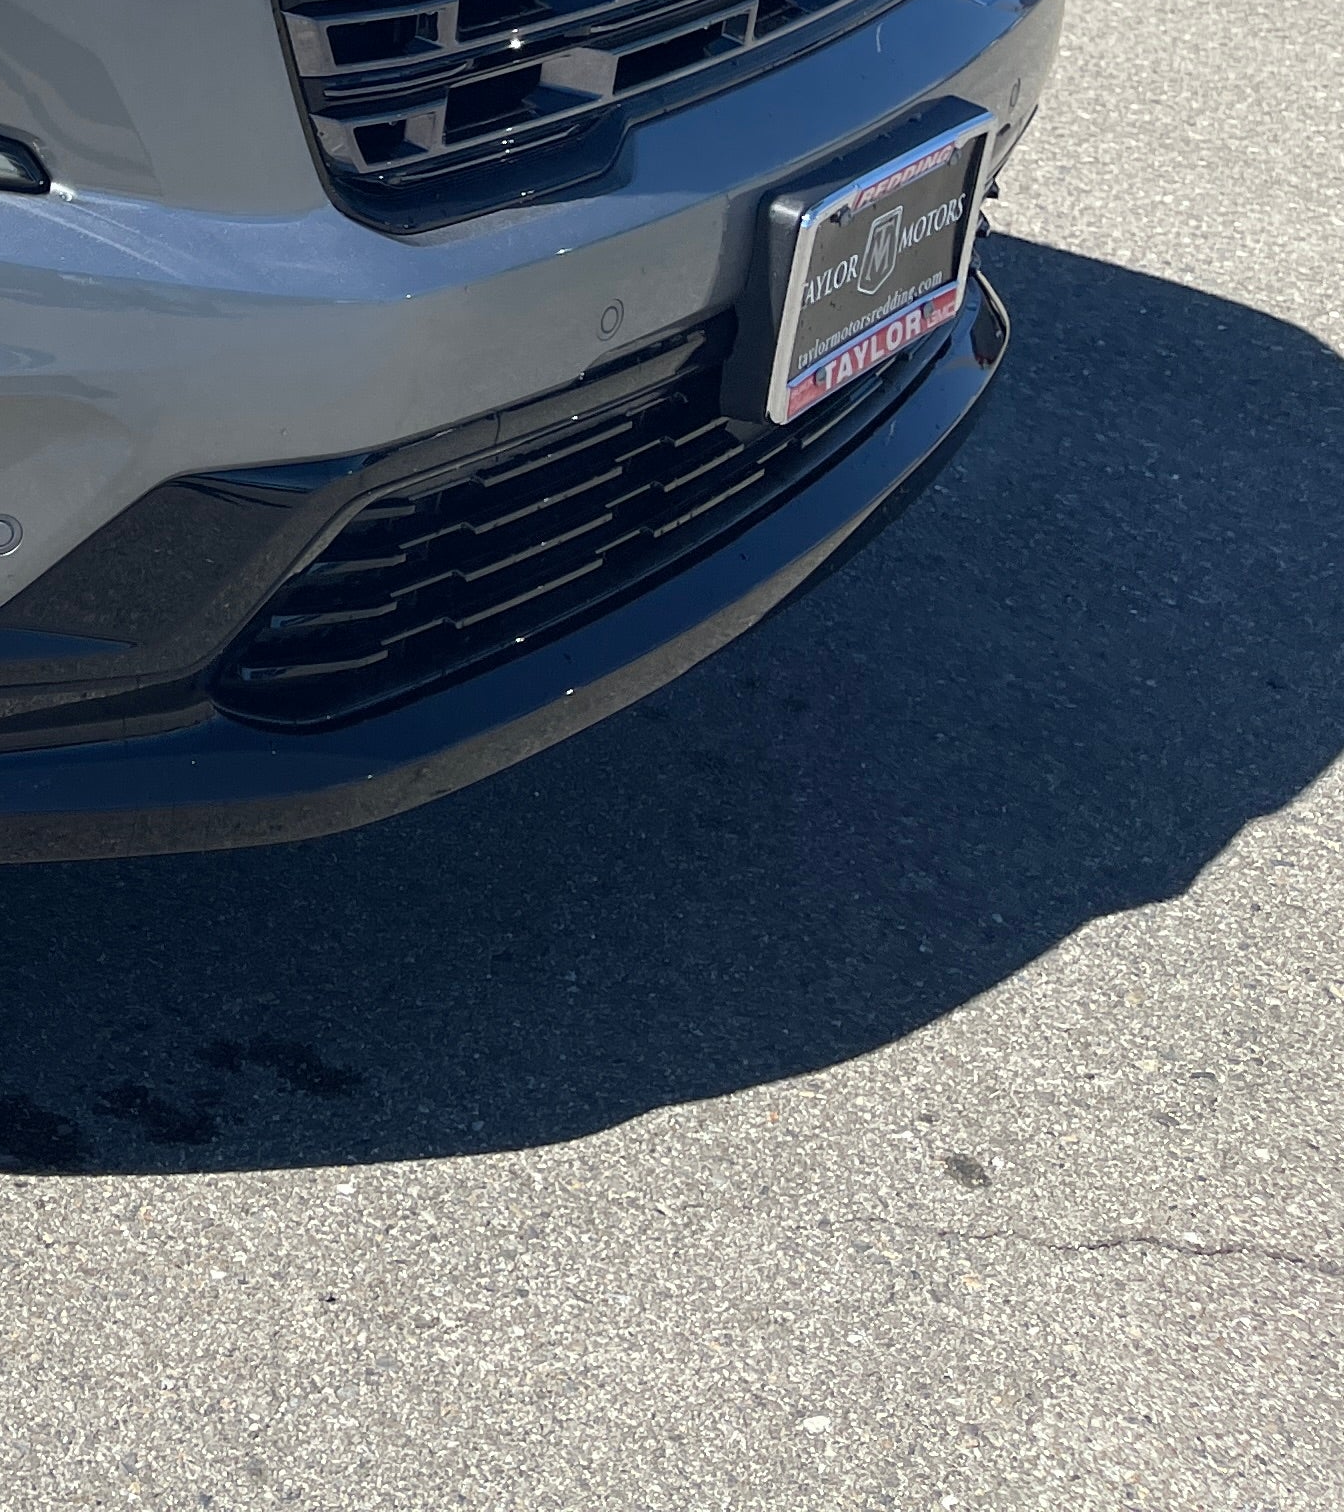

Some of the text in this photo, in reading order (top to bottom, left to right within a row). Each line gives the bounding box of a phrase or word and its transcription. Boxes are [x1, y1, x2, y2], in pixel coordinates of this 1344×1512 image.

[858, 144, 954, 206] REDDING
[898, 193, 966, 253] MOTORS
[798, 271, 943, 370] taylormotorsredding.com
[825, 309, 921, 389] TAYLOR
